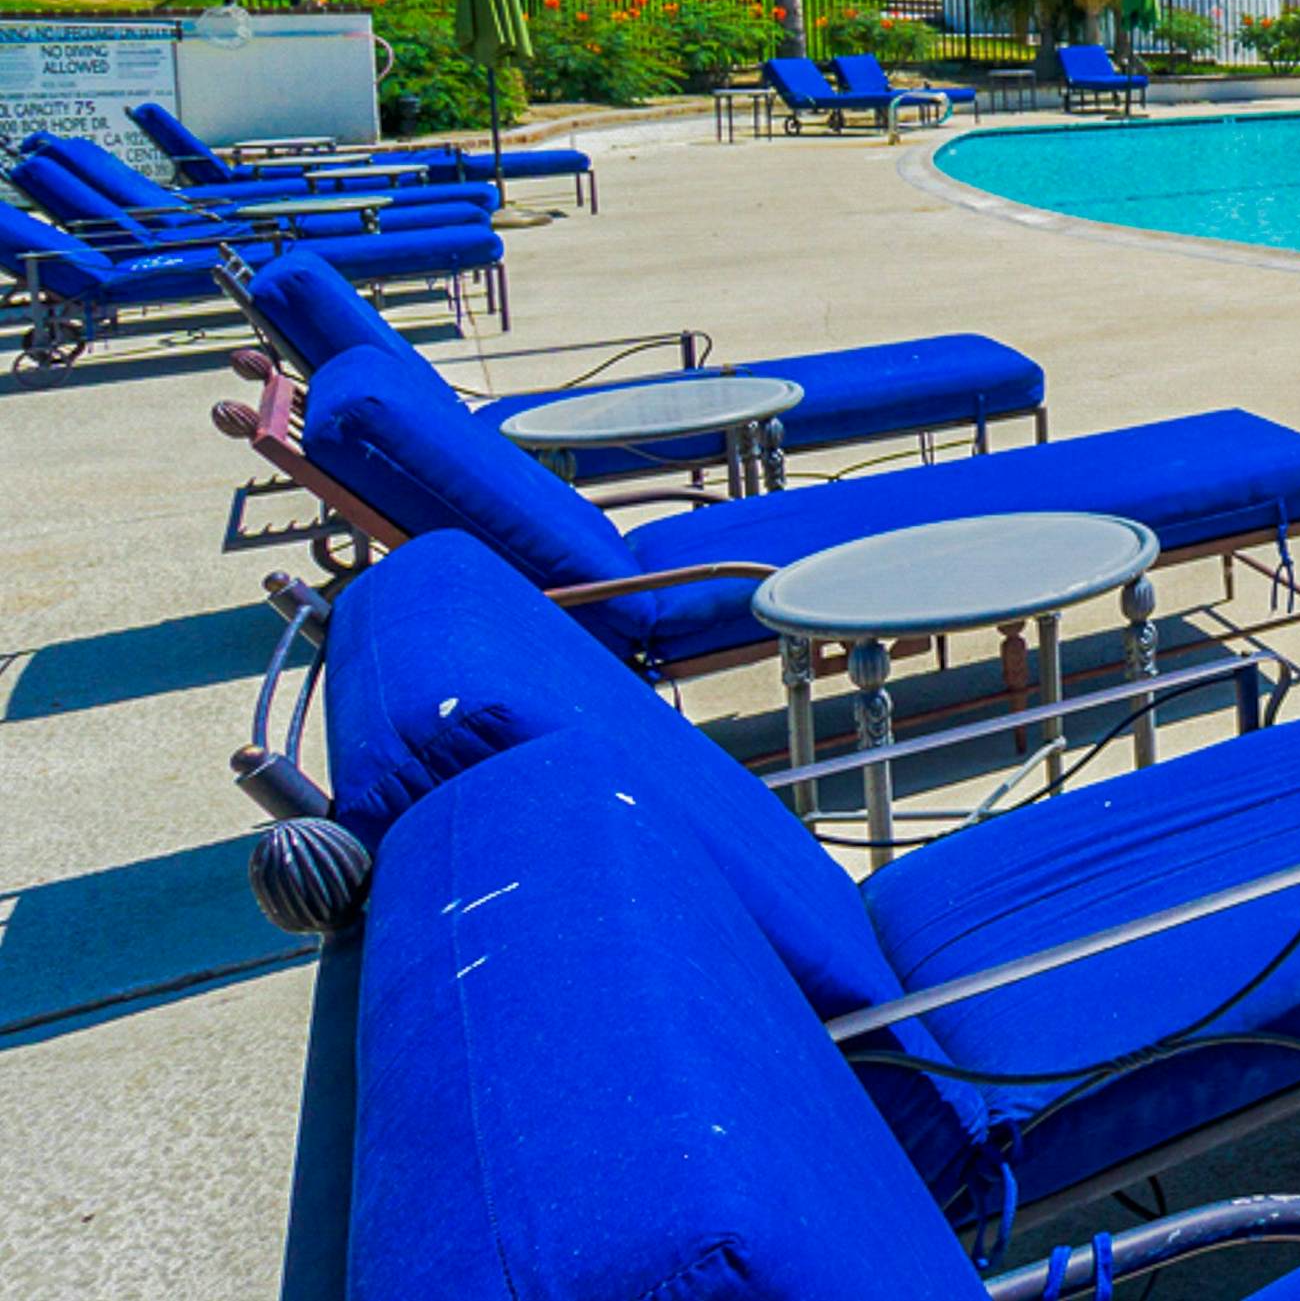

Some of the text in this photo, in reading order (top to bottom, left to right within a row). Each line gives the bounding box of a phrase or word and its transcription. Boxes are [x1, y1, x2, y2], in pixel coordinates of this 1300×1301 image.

[41, 44, 109, 58] NO DIVING
[42, 59, 110, 74] ALLOWED
[15, 102, 70, 118] CAPACITY
[74, 101, 96, 115] 75
[22, 118, 48, 133] BOB
[52, 117, 88, 132] HOPE
[103, 133, 123, 147] CA
